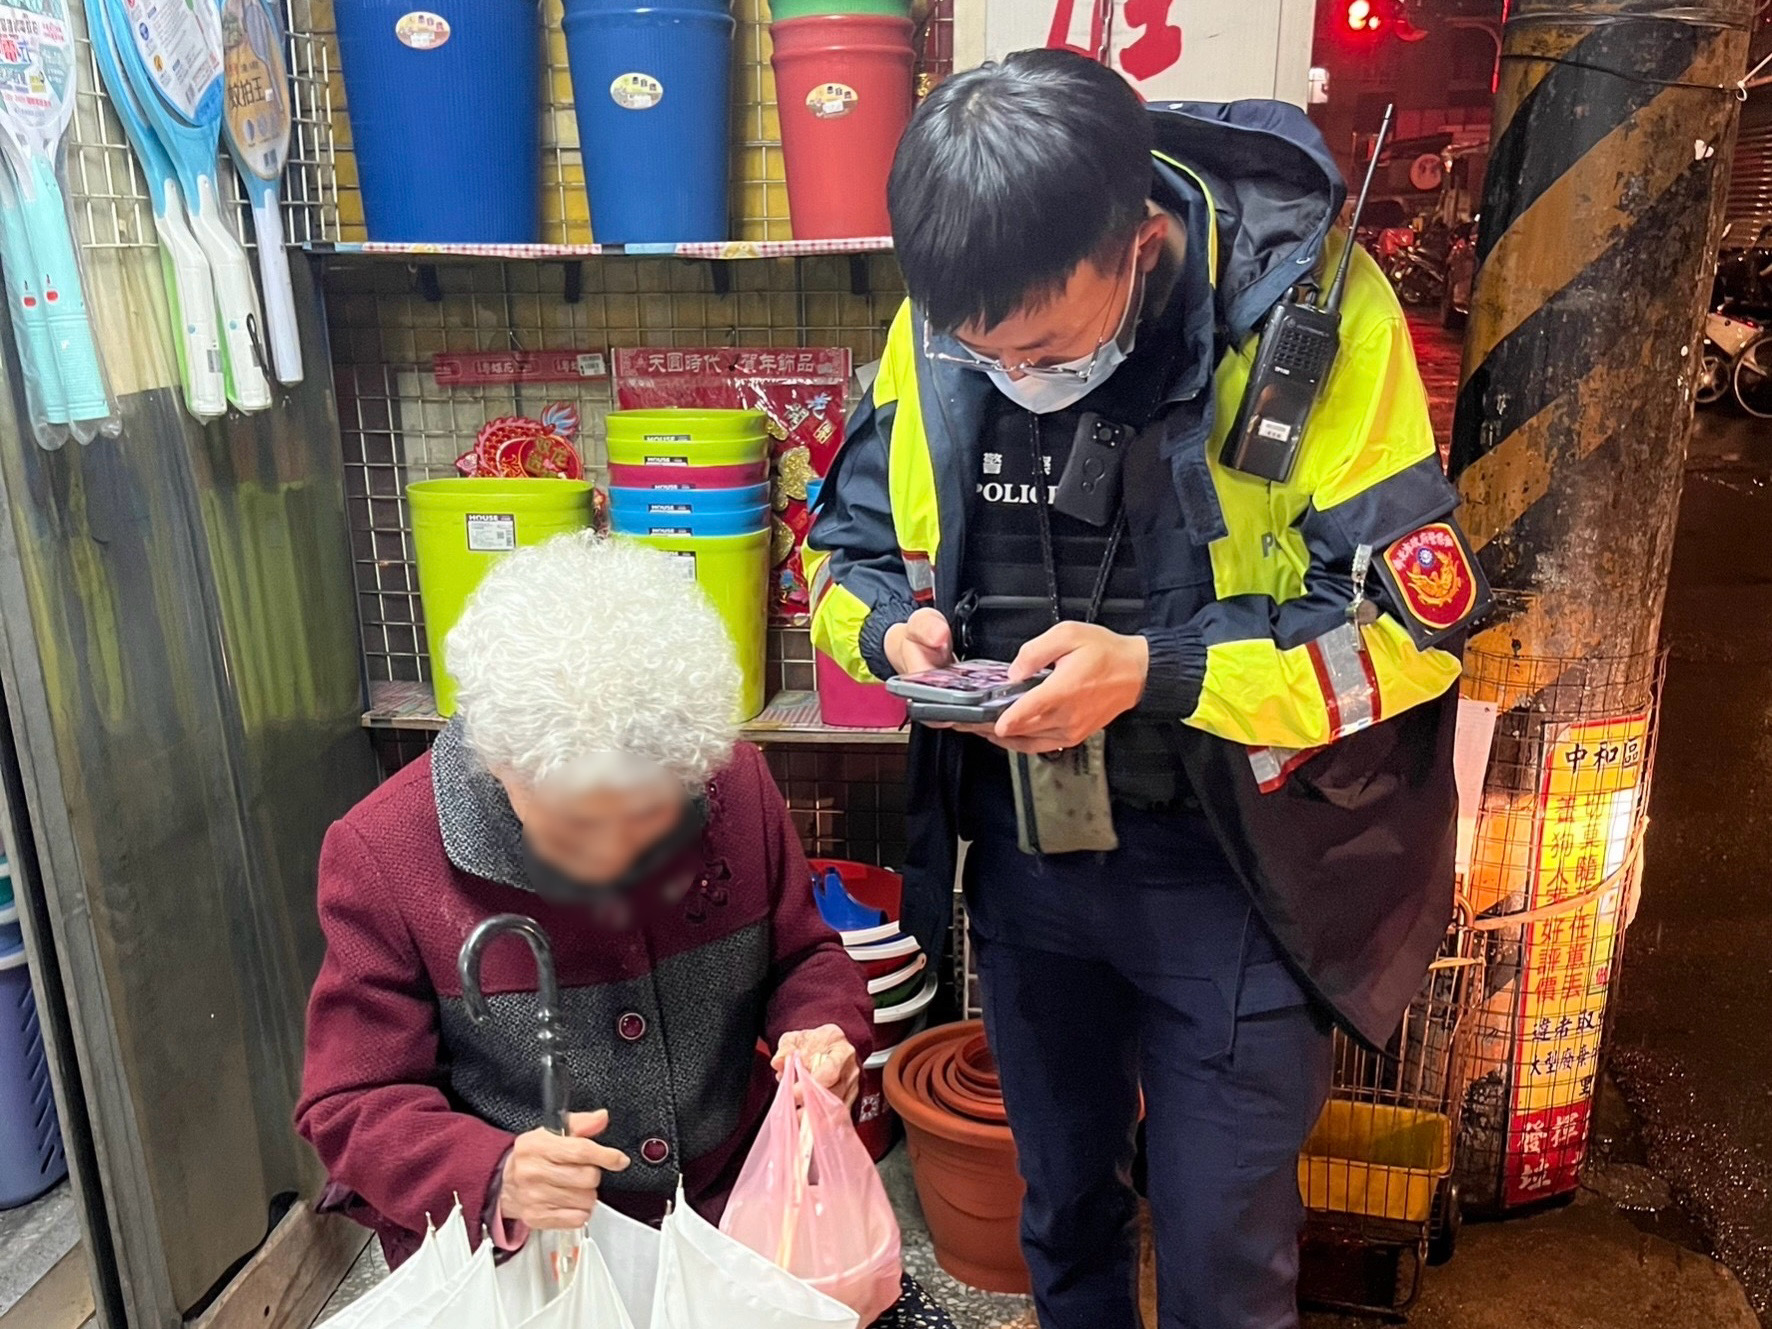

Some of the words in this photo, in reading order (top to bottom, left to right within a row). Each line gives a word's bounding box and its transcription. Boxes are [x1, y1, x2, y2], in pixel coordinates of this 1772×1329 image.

[648, 352, 722, 373] 天圓時代
[740, 352, 815, 373] 賀年飾品
[976, 482, 1058, 505] OLI
[1565, 737, 1640, 774] 中和區
[1532, 1009, 1603, 1041] 違者取
